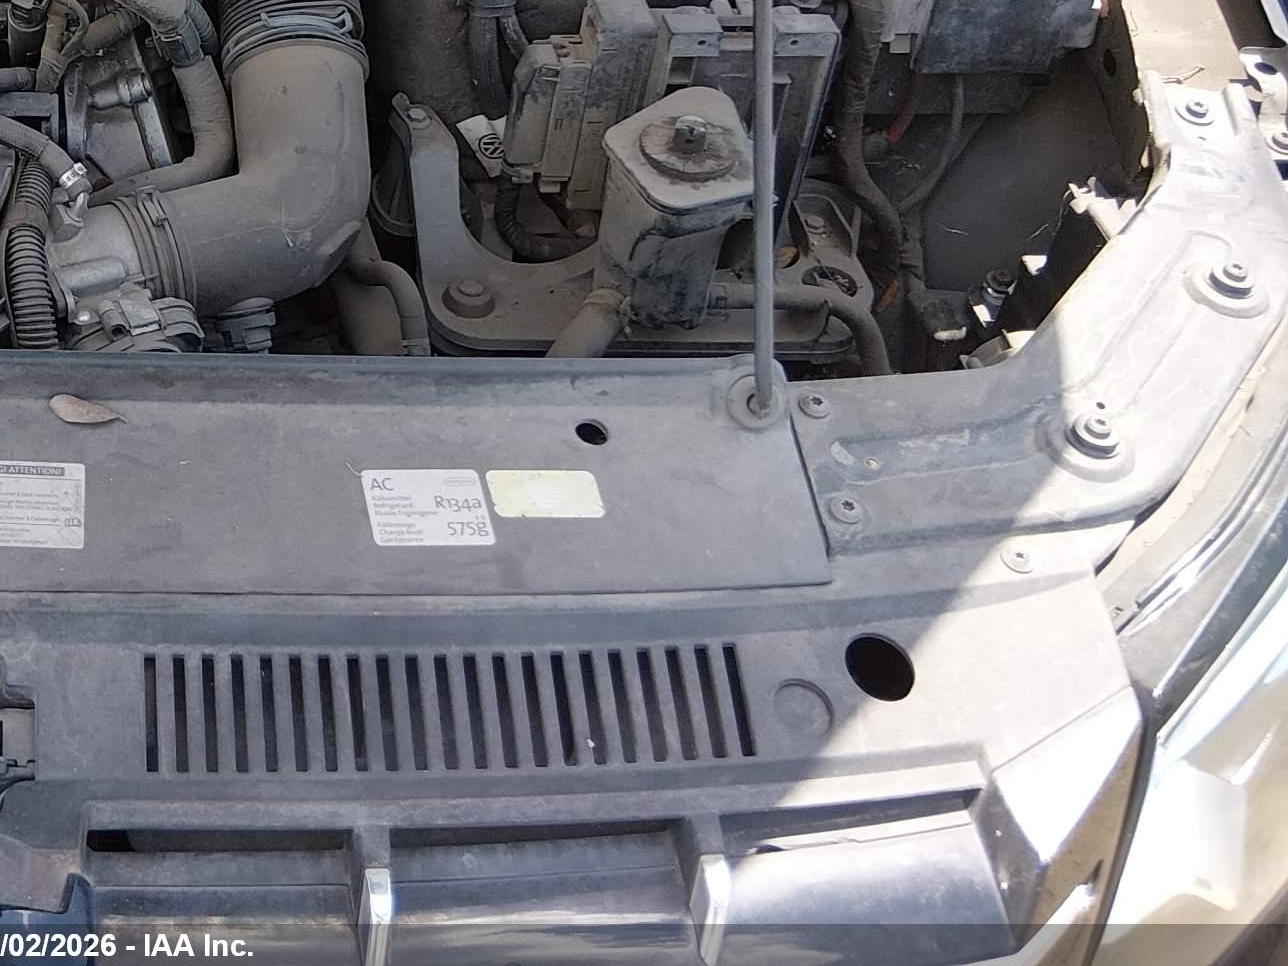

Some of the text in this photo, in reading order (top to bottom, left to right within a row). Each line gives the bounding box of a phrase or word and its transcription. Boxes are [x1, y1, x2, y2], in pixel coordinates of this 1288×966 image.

[8, 465, 63, 475] ATTENTION!
[370, 477, 394, 491] AC
[433, 495, 482, 513] R134a
[447, 521, 490, 537] 575g
